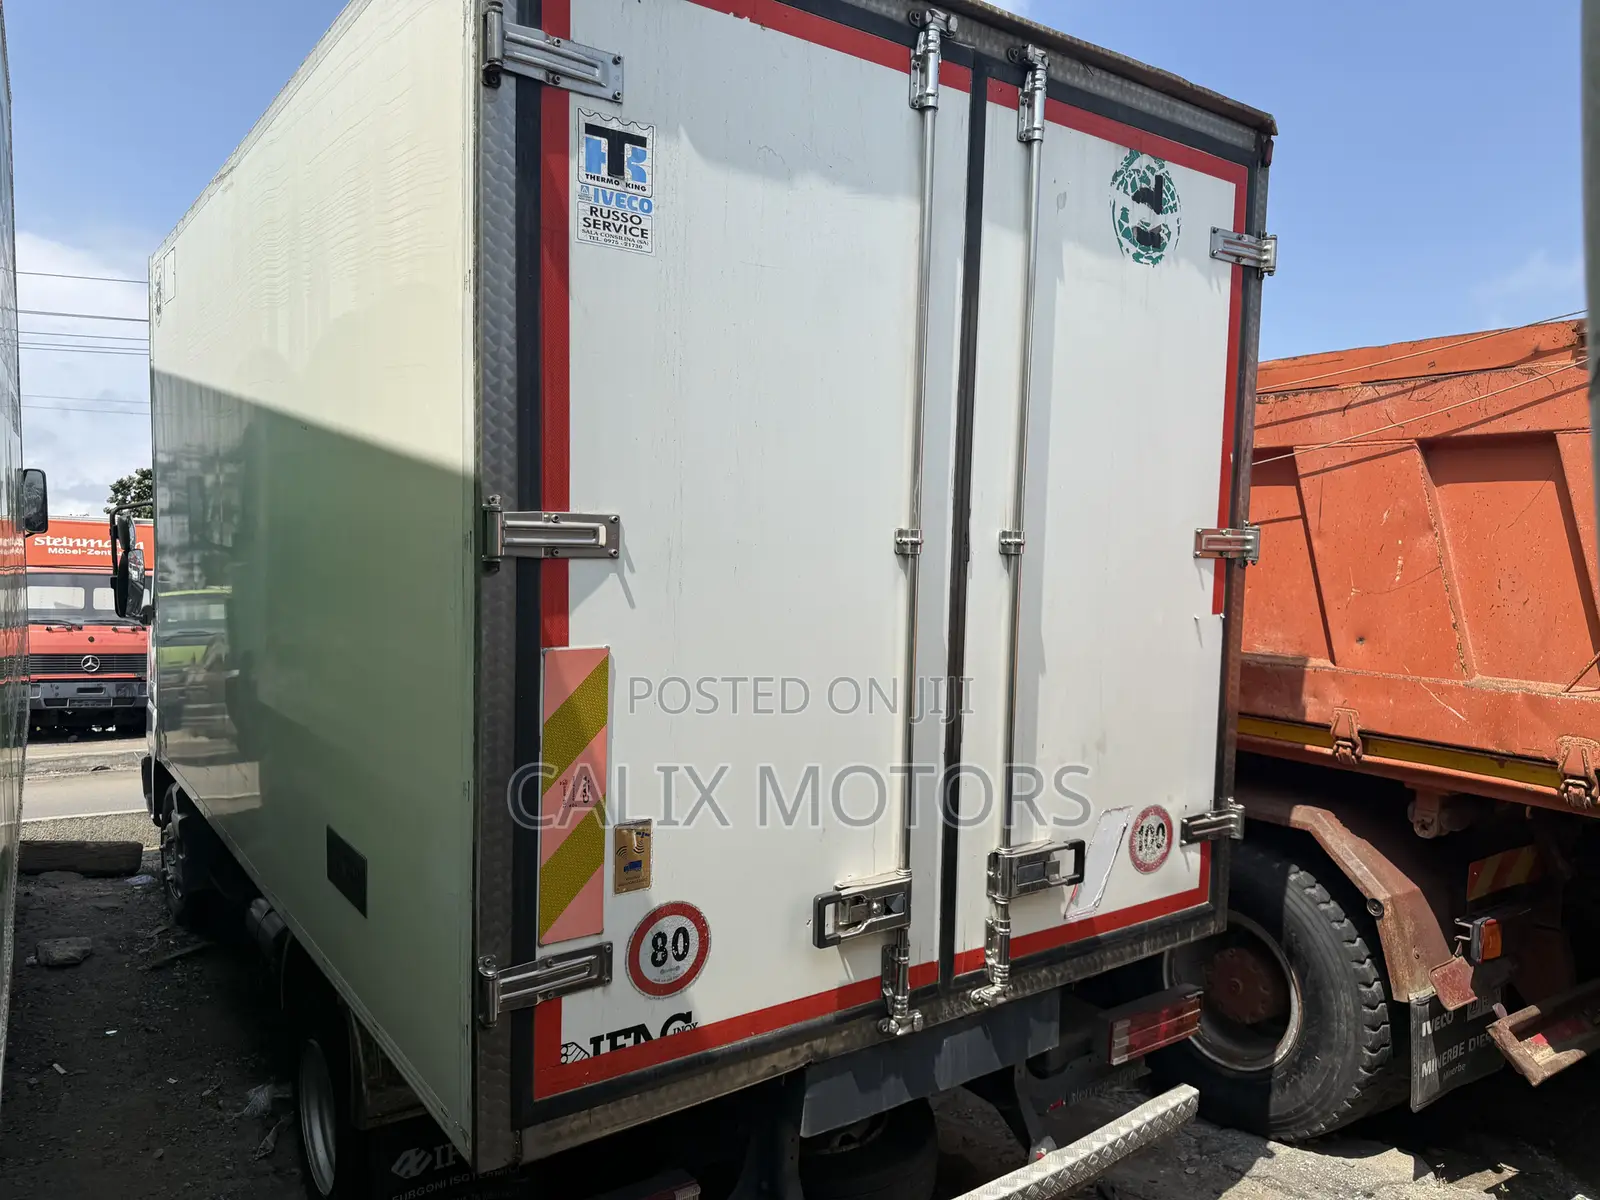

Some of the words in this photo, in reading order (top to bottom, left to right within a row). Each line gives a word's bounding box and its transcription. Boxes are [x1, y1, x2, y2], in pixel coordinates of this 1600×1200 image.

[585, 173, 620, 186] THERMO
[625, 182, 647, 192] KING
[593, 187, 653, 214] IVECO
[589, 206, 642, 225] RUSSO
[582, 217, 649, 239] SERVICE
[582, 228, 599, 236] SALA
[650, 926, 690, 968] 80
[1421, 1010, 1454, 1037] IVECO
[1421, 1040, 1466, 1078] MINERBE
